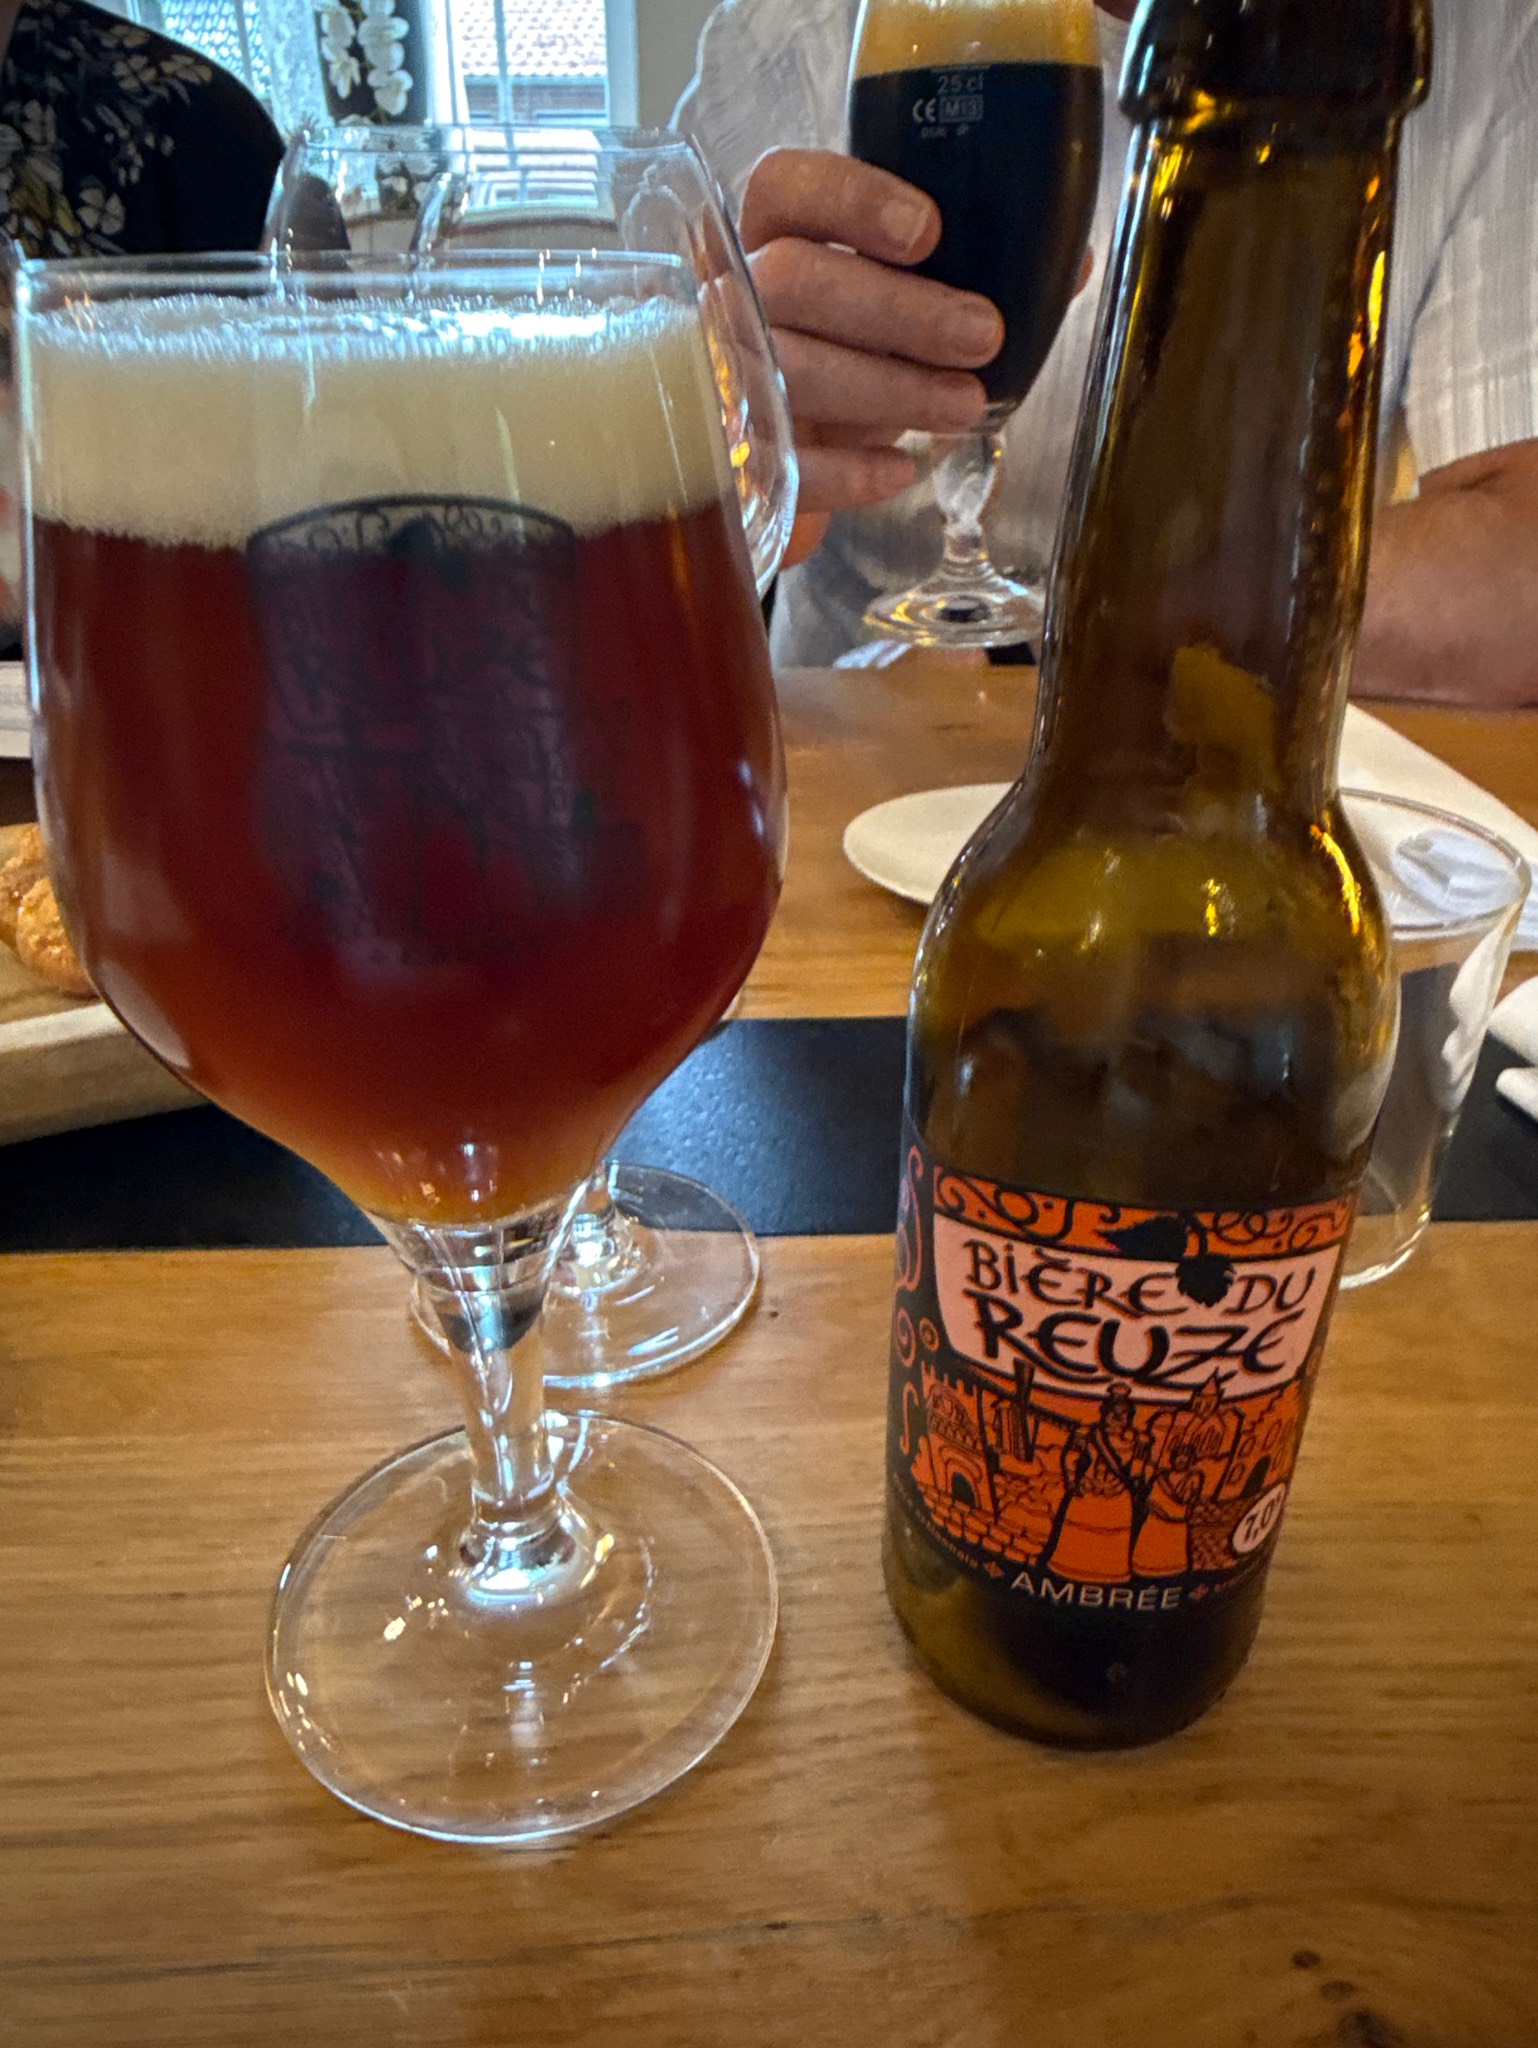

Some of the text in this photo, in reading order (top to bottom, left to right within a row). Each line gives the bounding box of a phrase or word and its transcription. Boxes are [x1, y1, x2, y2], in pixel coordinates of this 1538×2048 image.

[1223, 1266, 1317, 1317] DU
[963, 1287, 1306, 1390] REUZE
[1010, 1571, 1184, 1612] AMBRÉE
